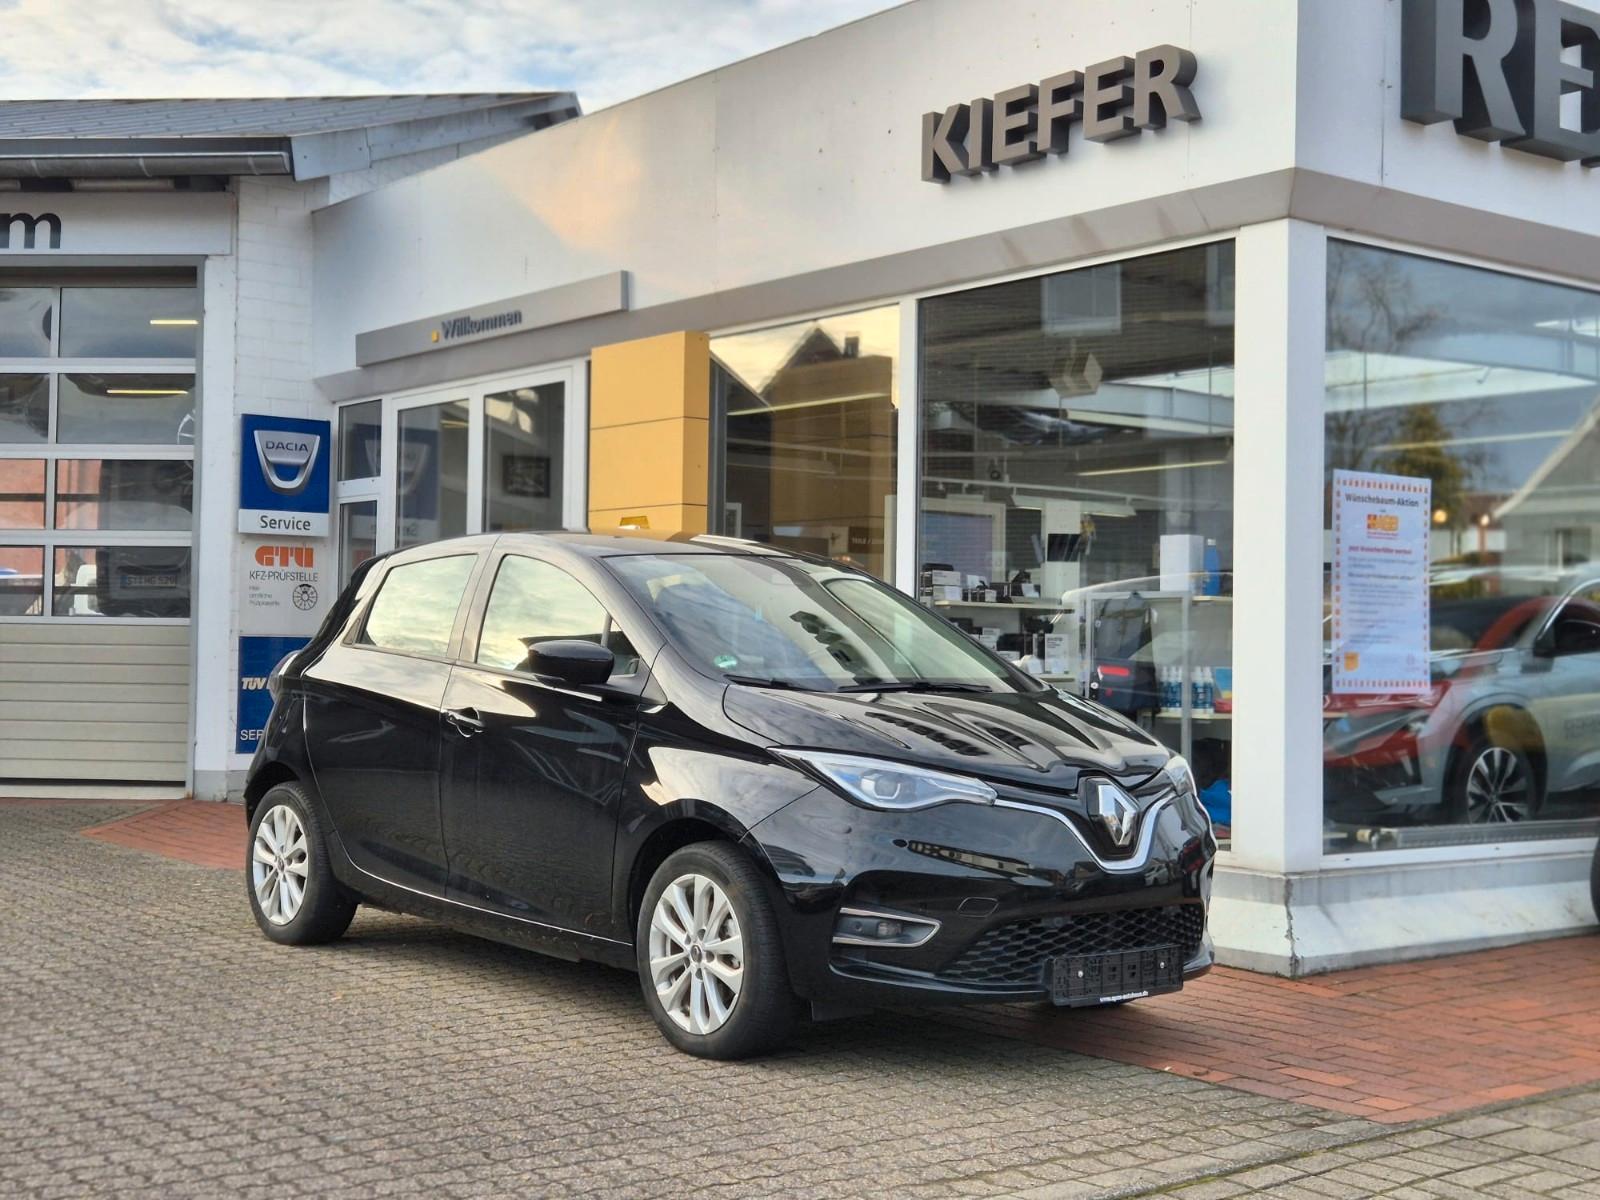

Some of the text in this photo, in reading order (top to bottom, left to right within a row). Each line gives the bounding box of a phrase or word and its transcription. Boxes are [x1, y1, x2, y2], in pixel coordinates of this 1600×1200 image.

[921, 44, 1202, 184] KIEFER
[441, 309, 522, 340] Willkommen
[265, 440, 309, 453] DACIA
[260, 515, 311, 531] Service
[249, 569, 319, 582] KFZ-PRÜFSTELLE
